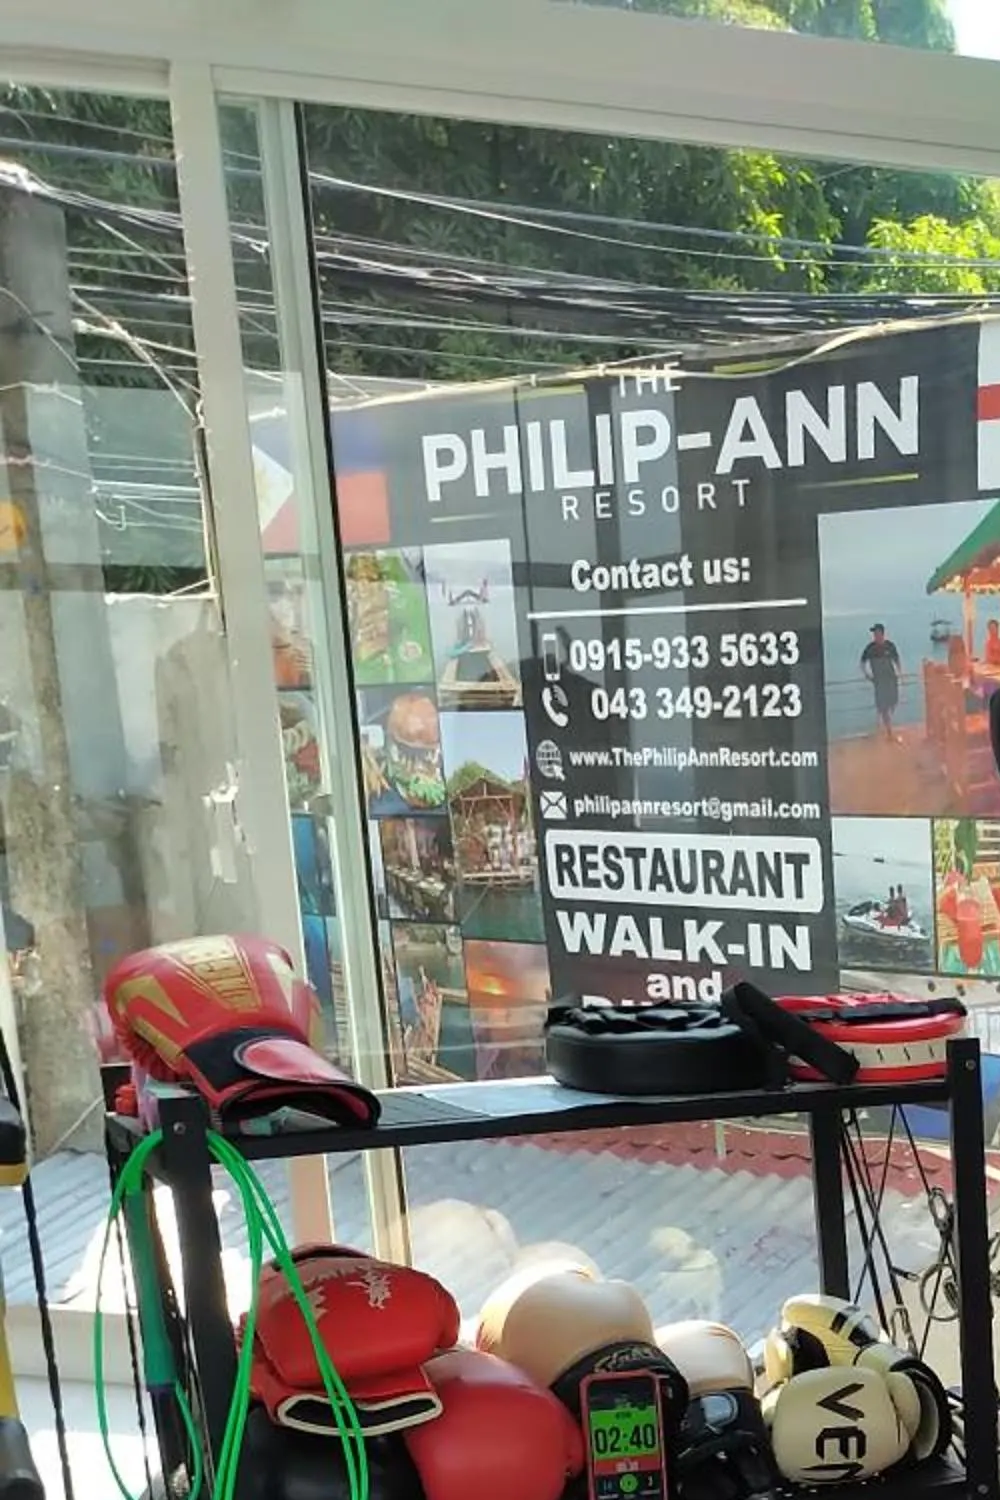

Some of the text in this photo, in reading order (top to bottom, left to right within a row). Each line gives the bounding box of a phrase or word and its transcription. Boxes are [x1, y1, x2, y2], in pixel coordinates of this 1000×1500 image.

[619, 361, 682, 398] THE
[422, 375, 919, 502] PHILIP-ANN
[561, 479, 751, 521] RESORT
[571, 554, 750, 592] Contact us:
[569, 631, 799, 671] 0915-933 5633
[591, 683, 802, 720] 043 349-2123
[569, 747, 818, 771] www.ThePhilipAnnResort.com
[574, 795, 821, 822] philipannresort@gmail.com
[554, 842, 811, 900] RESTAURANT
[555, 911, 812, 971] WALK-IN
[646, 971, 722, 1006] and
[594, 1423, 657, 1454] 02:40
